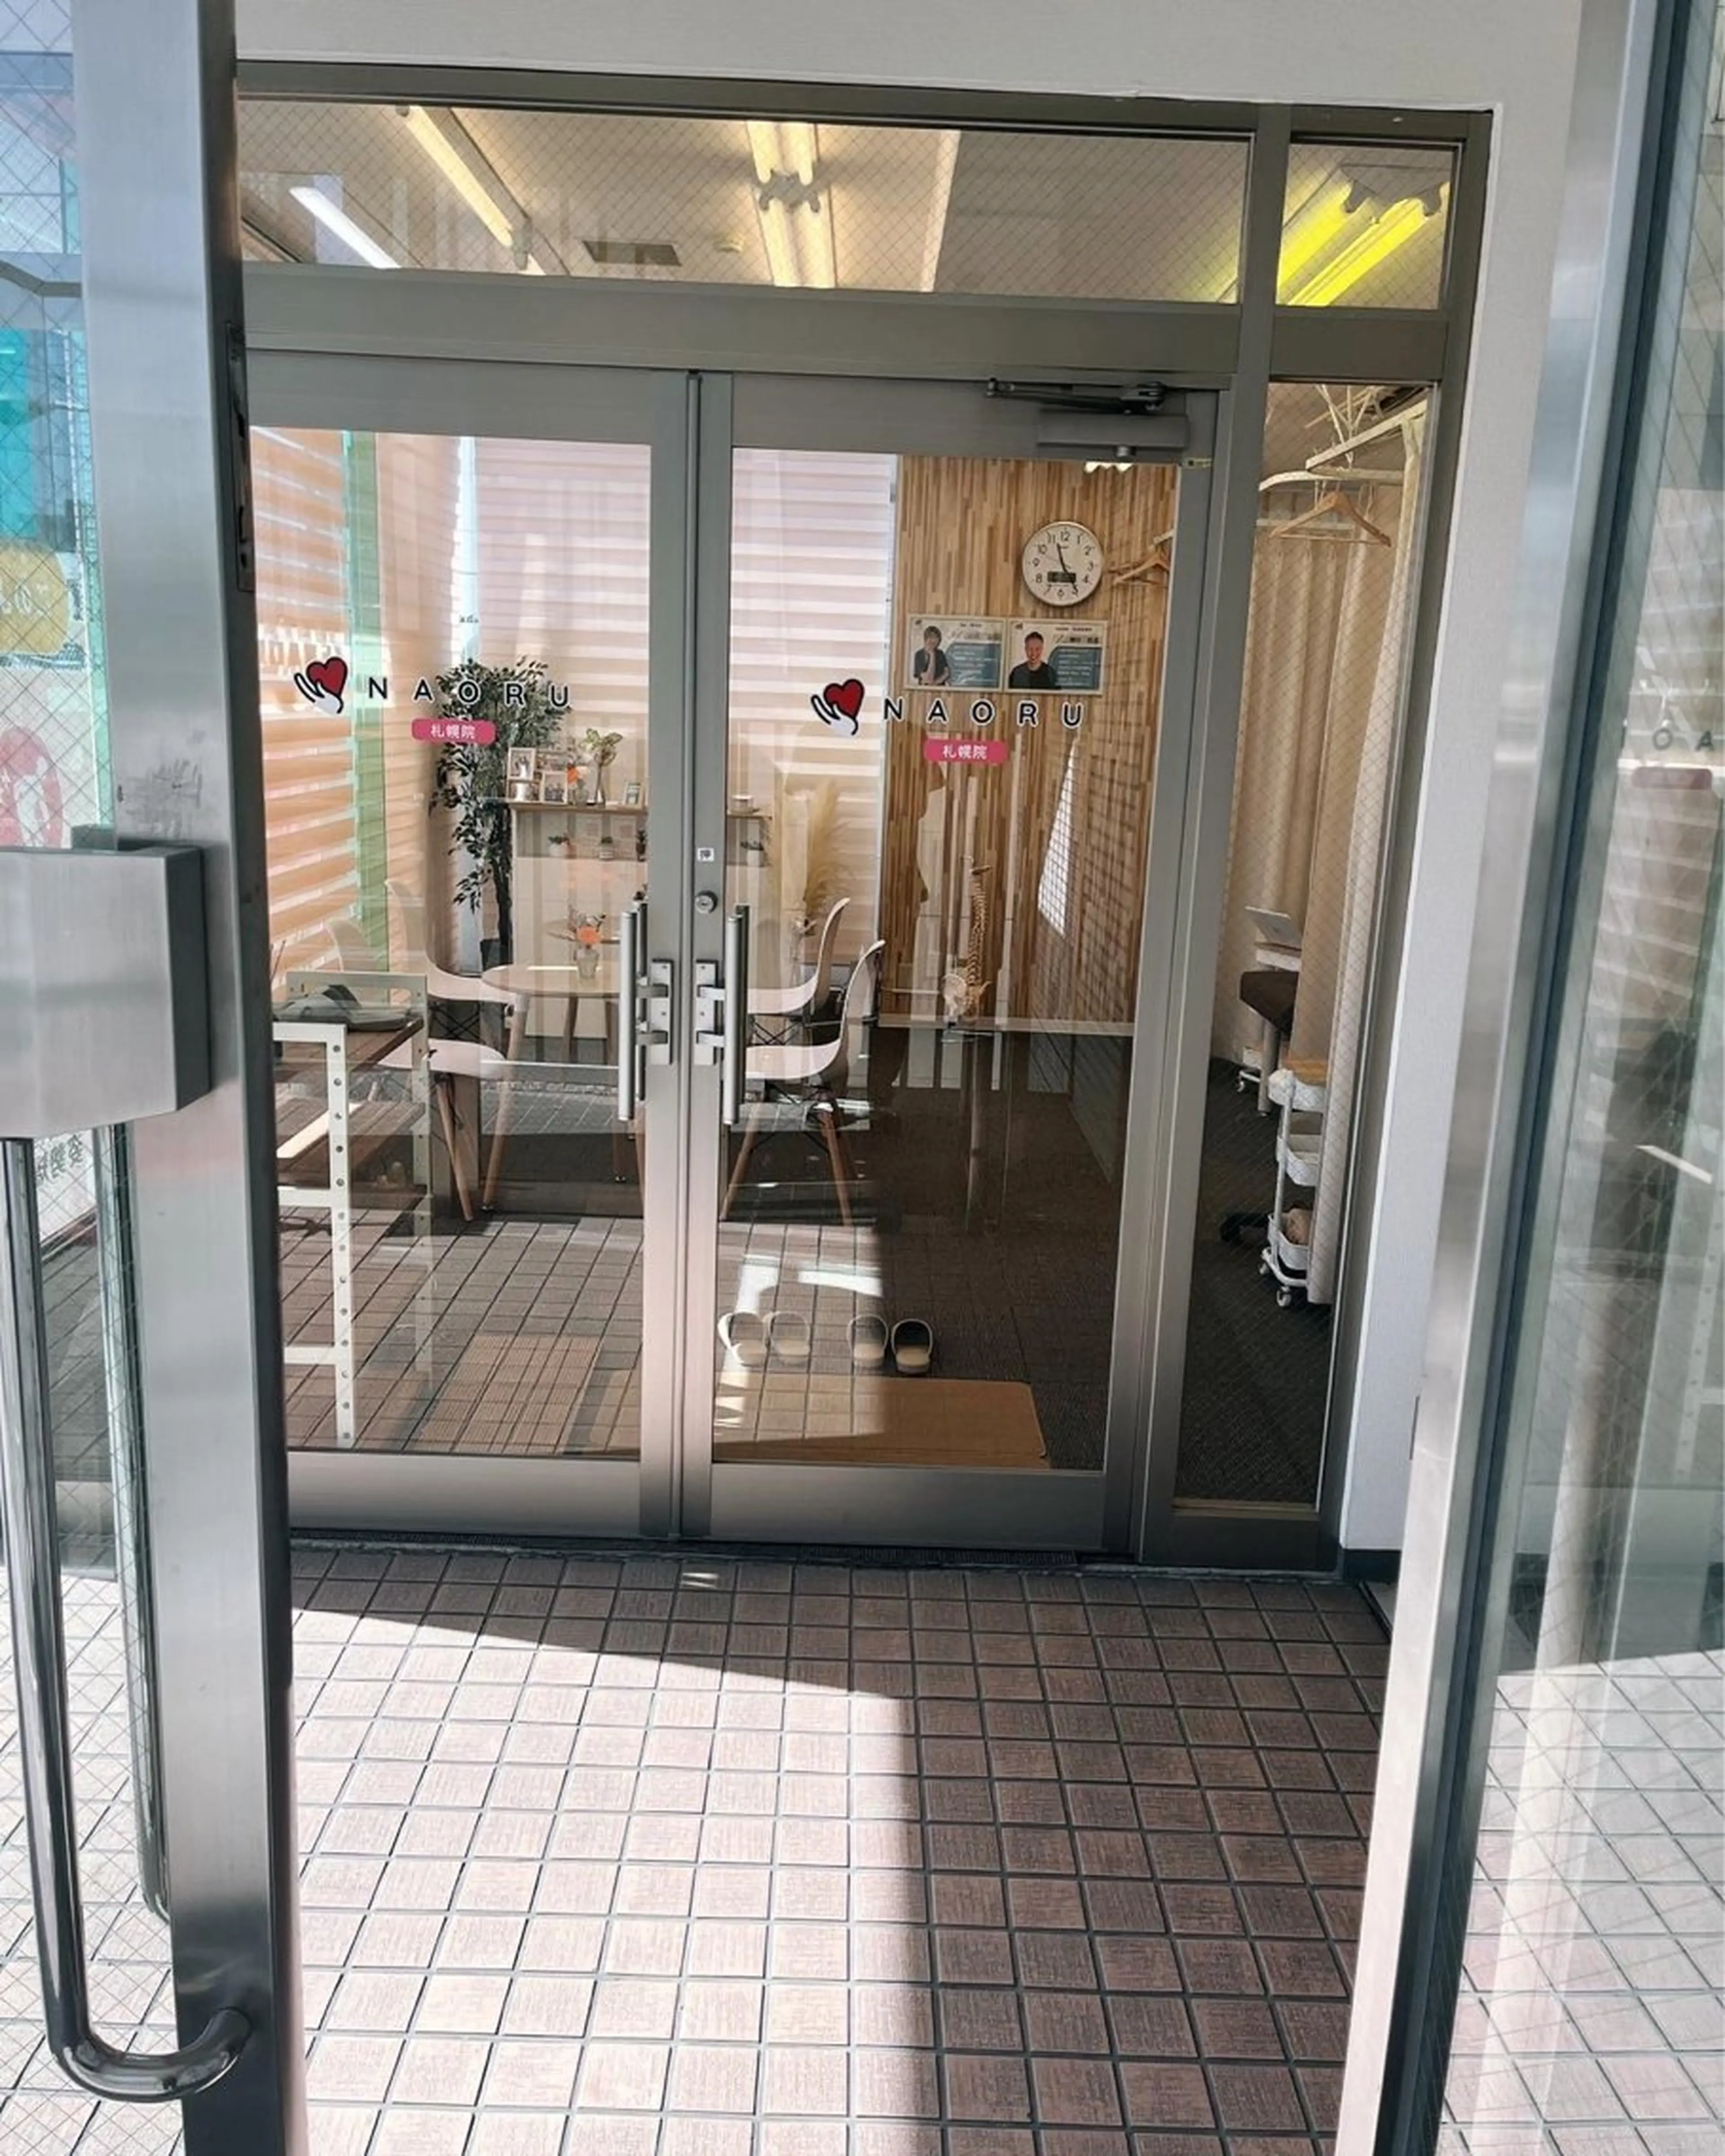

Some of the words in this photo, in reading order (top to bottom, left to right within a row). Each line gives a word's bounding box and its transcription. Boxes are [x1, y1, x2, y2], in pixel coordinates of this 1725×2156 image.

[1060, 531, 1070, 541] 12
[1038, 544, 1048, 555] 10
[1032, 558, 1040, 567] 9
[1036, 573, 1043, 583] 8
[369, 677, 568, 706] NAORU
[885, 699, 1082, 726] NAORU
[431, 723, 475, 739] 札幌院
[943, 744, 987, 759] 札幌院
